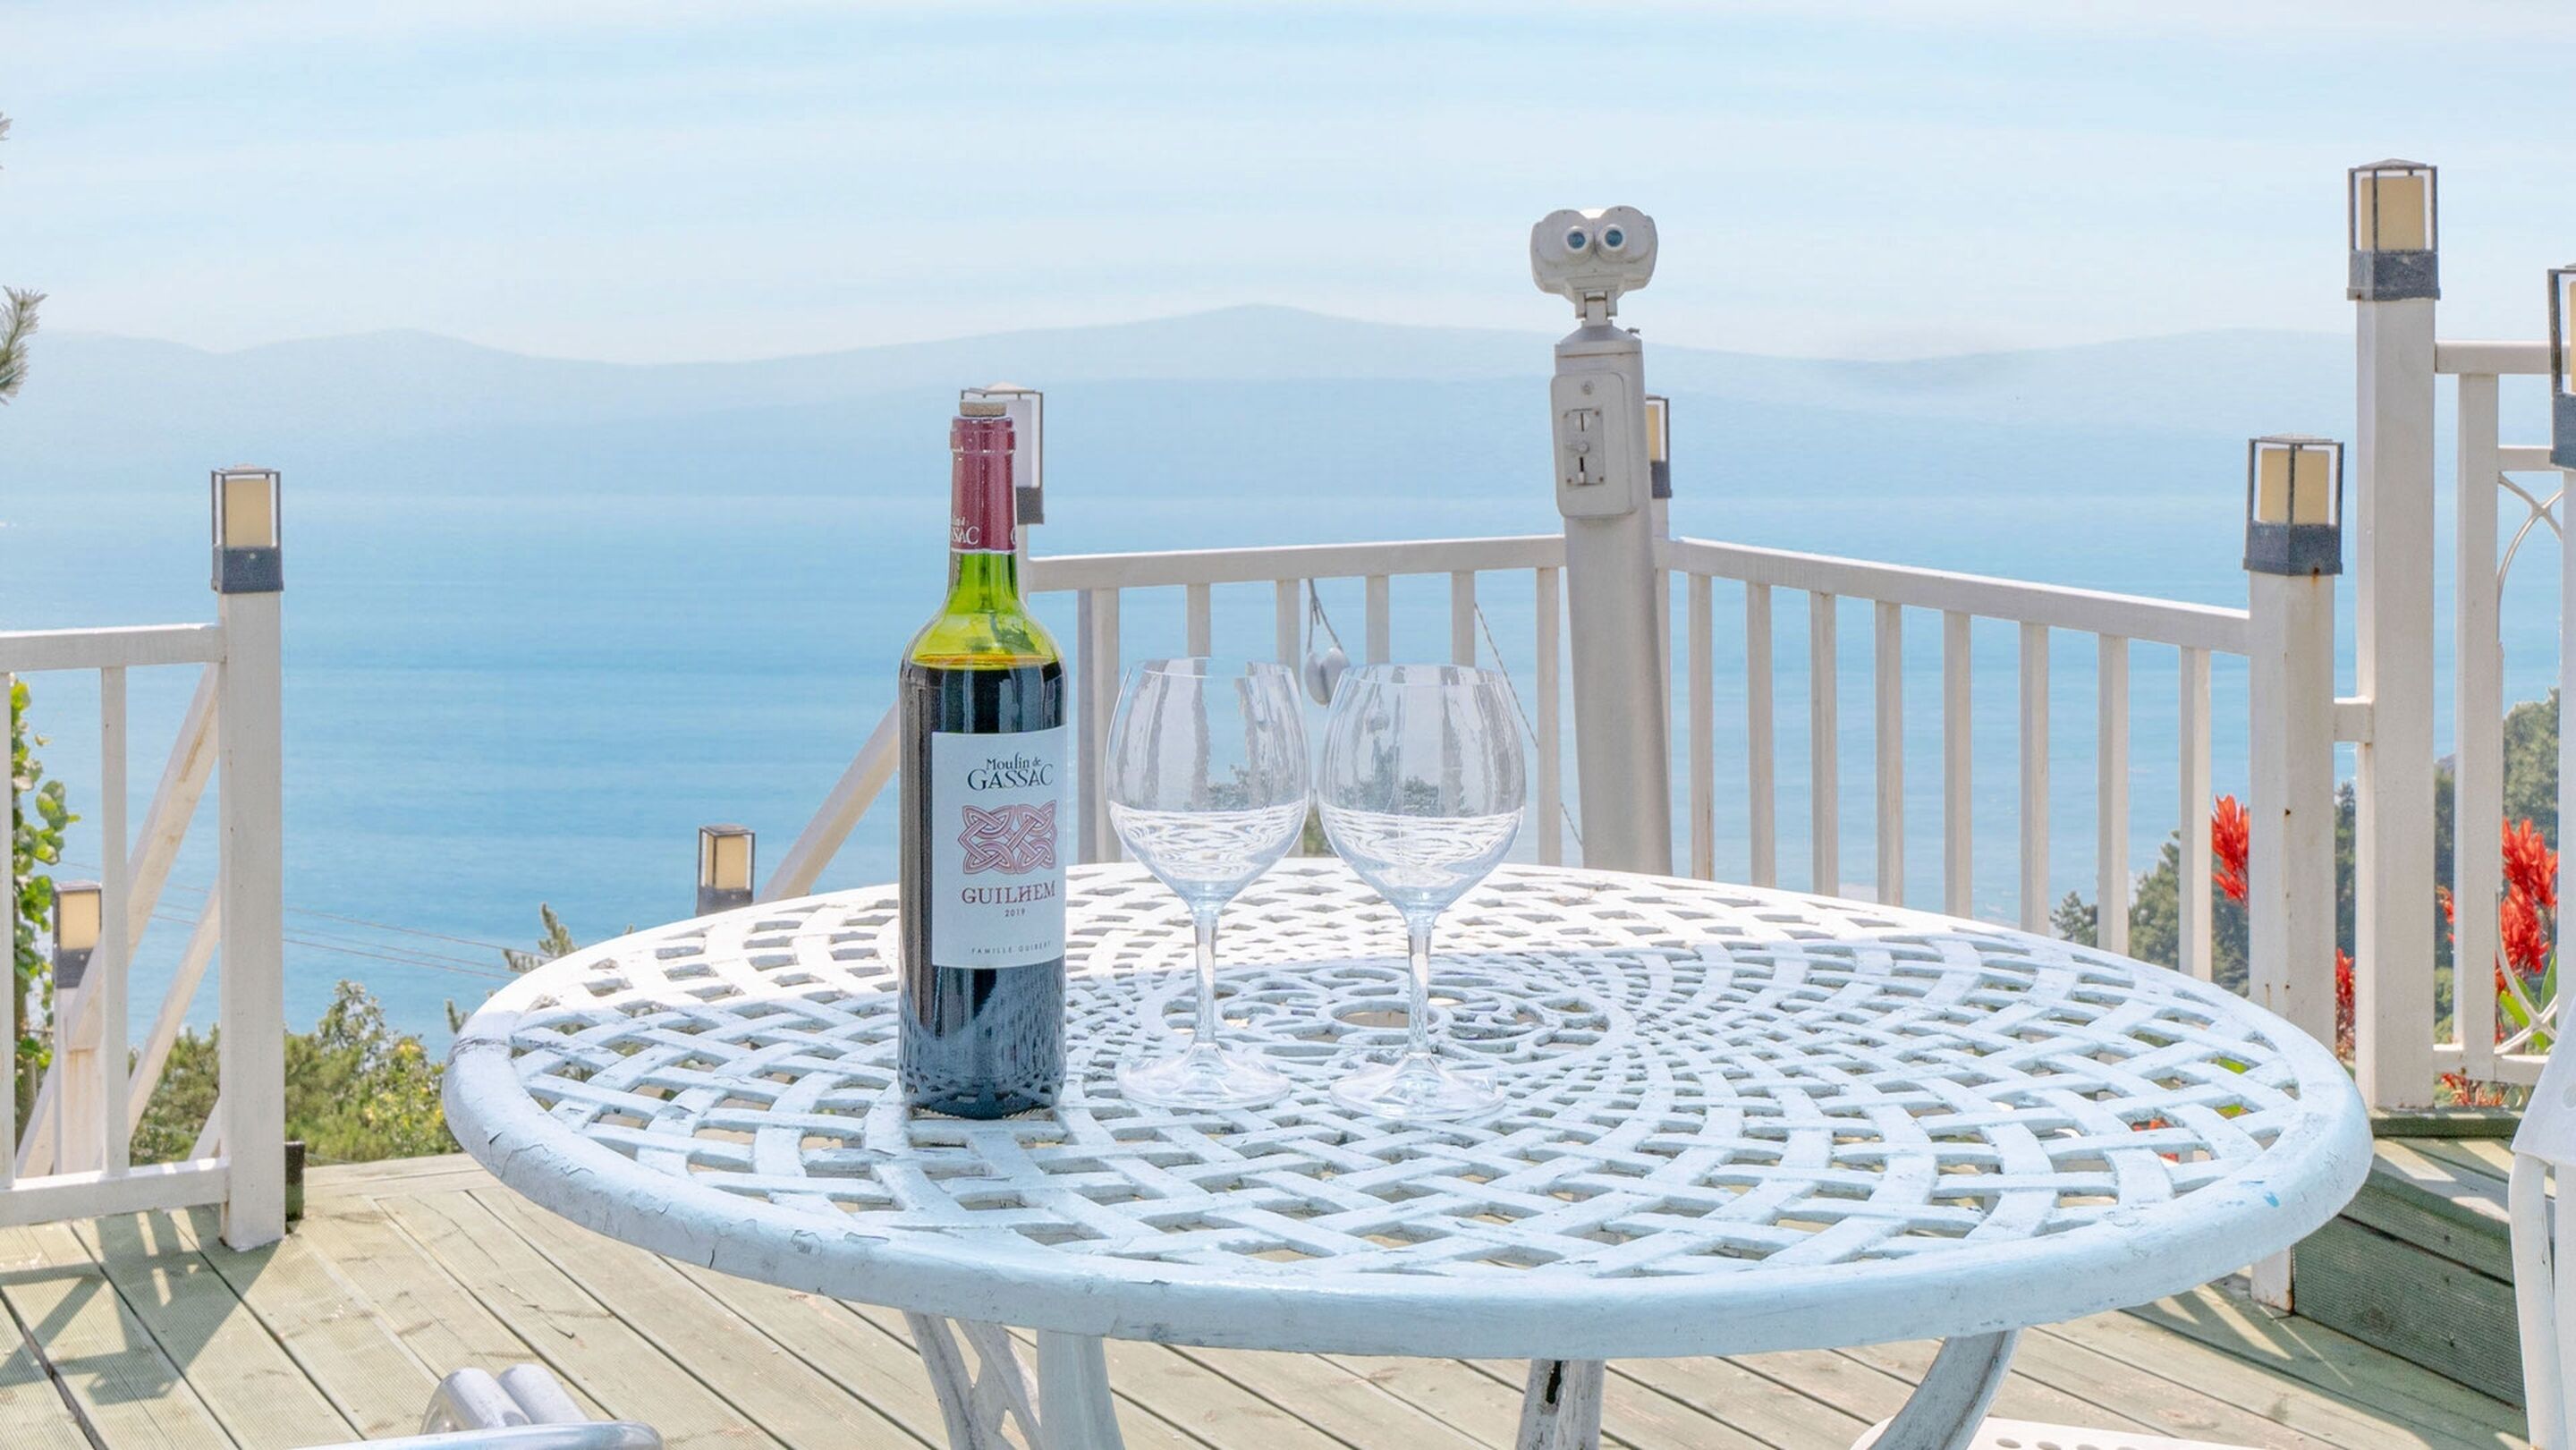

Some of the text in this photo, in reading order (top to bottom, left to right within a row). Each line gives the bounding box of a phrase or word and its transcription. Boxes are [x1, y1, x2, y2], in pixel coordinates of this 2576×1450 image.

[986, 751, 1030, 771] Moulin
[967, 763, 1054, 792] GASSAC
[962, 879, 1056, 905] GUILHEM
[1004, 907, 1026, 918] 2019
[971, 945, 1013, 954] FAMILLE
